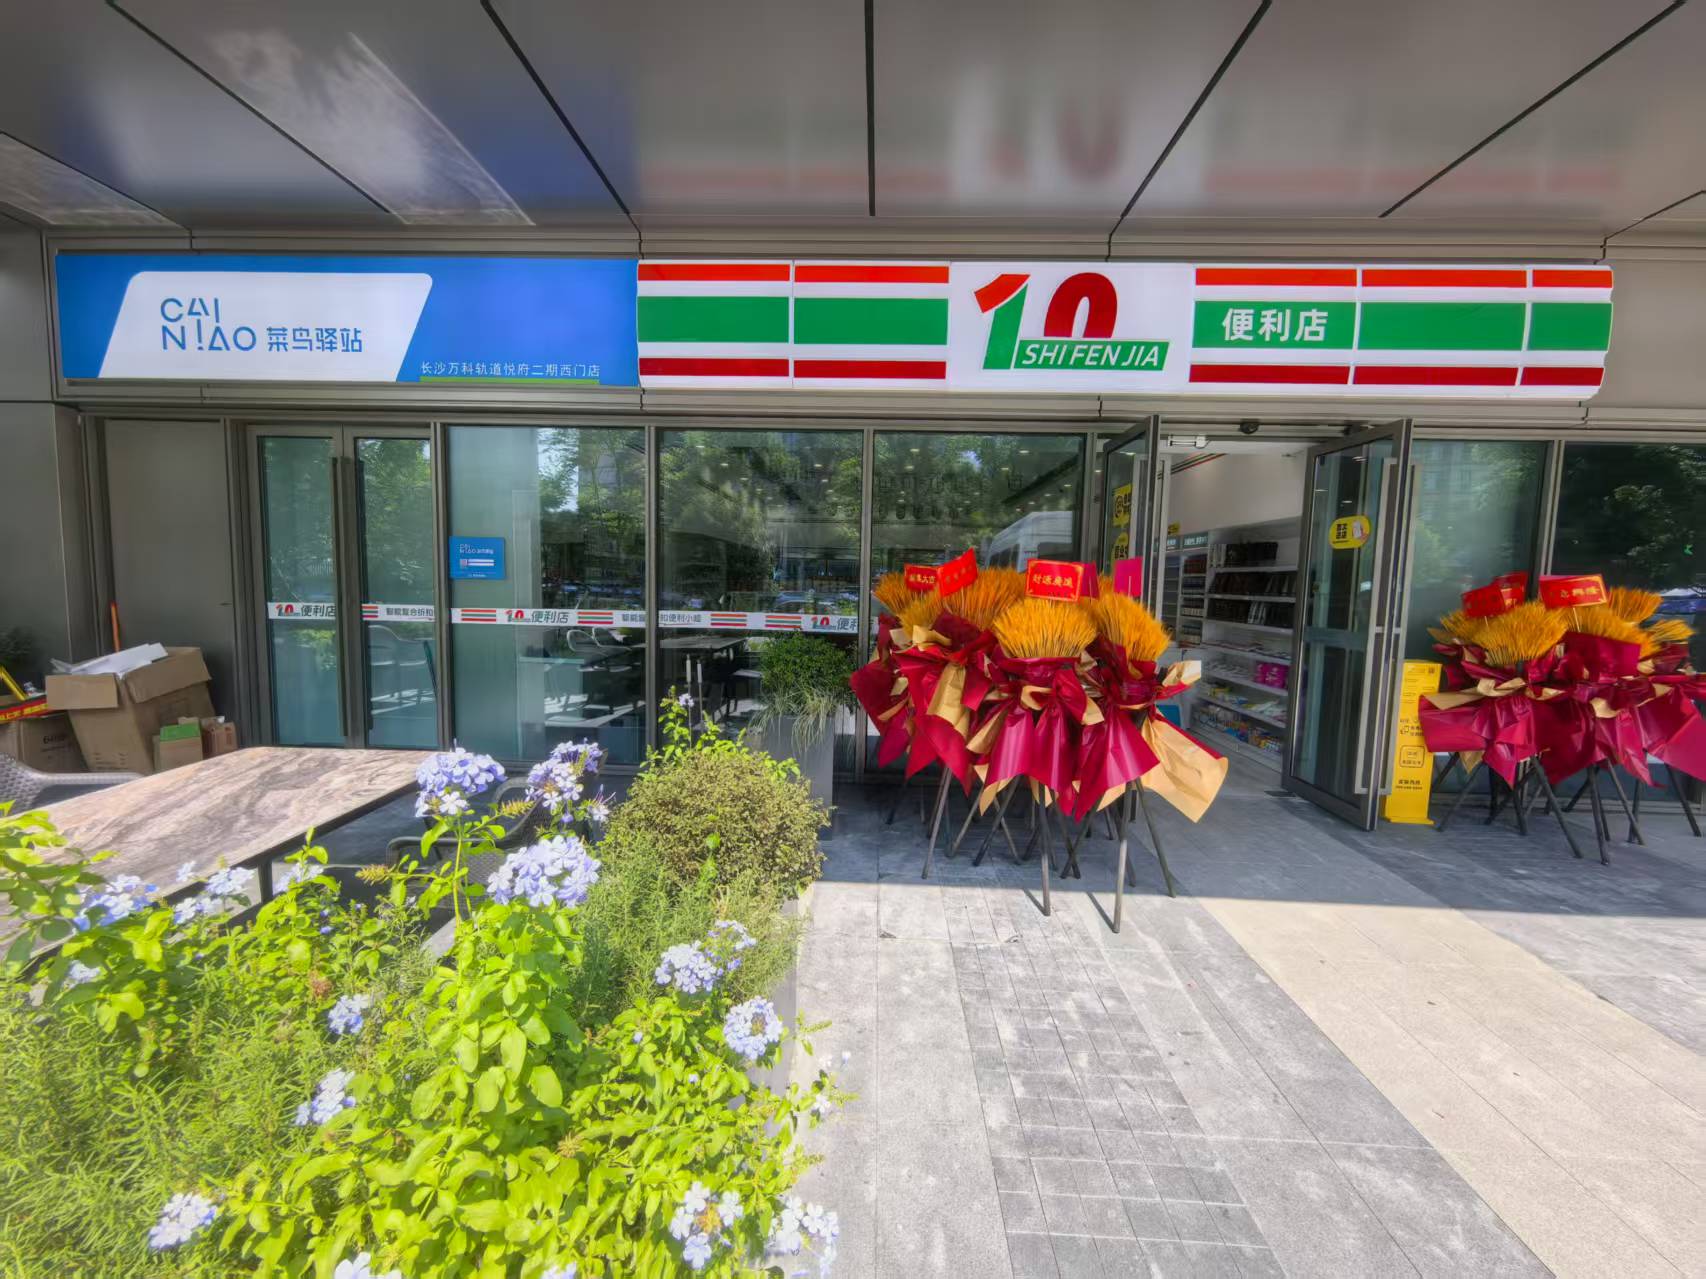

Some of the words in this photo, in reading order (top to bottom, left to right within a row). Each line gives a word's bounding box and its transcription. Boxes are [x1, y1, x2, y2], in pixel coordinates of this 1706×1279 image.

[160, 297, 220, 323] CAI
[1222, 308, 1329, 342] 便利店
[266, 326, 363, 353] 菜鸟驿站
[1022, 343, 1068, 366] SHI
[1069, 344, 1120, 367] FEN
[1120, 345, 1160, 367] JIA
[420, 361, 601, 377] 长沙万科轨道悦府二期西门店
[300, 604, 337, 617] 便利店
[531, 610, 570, 624] 便利店
